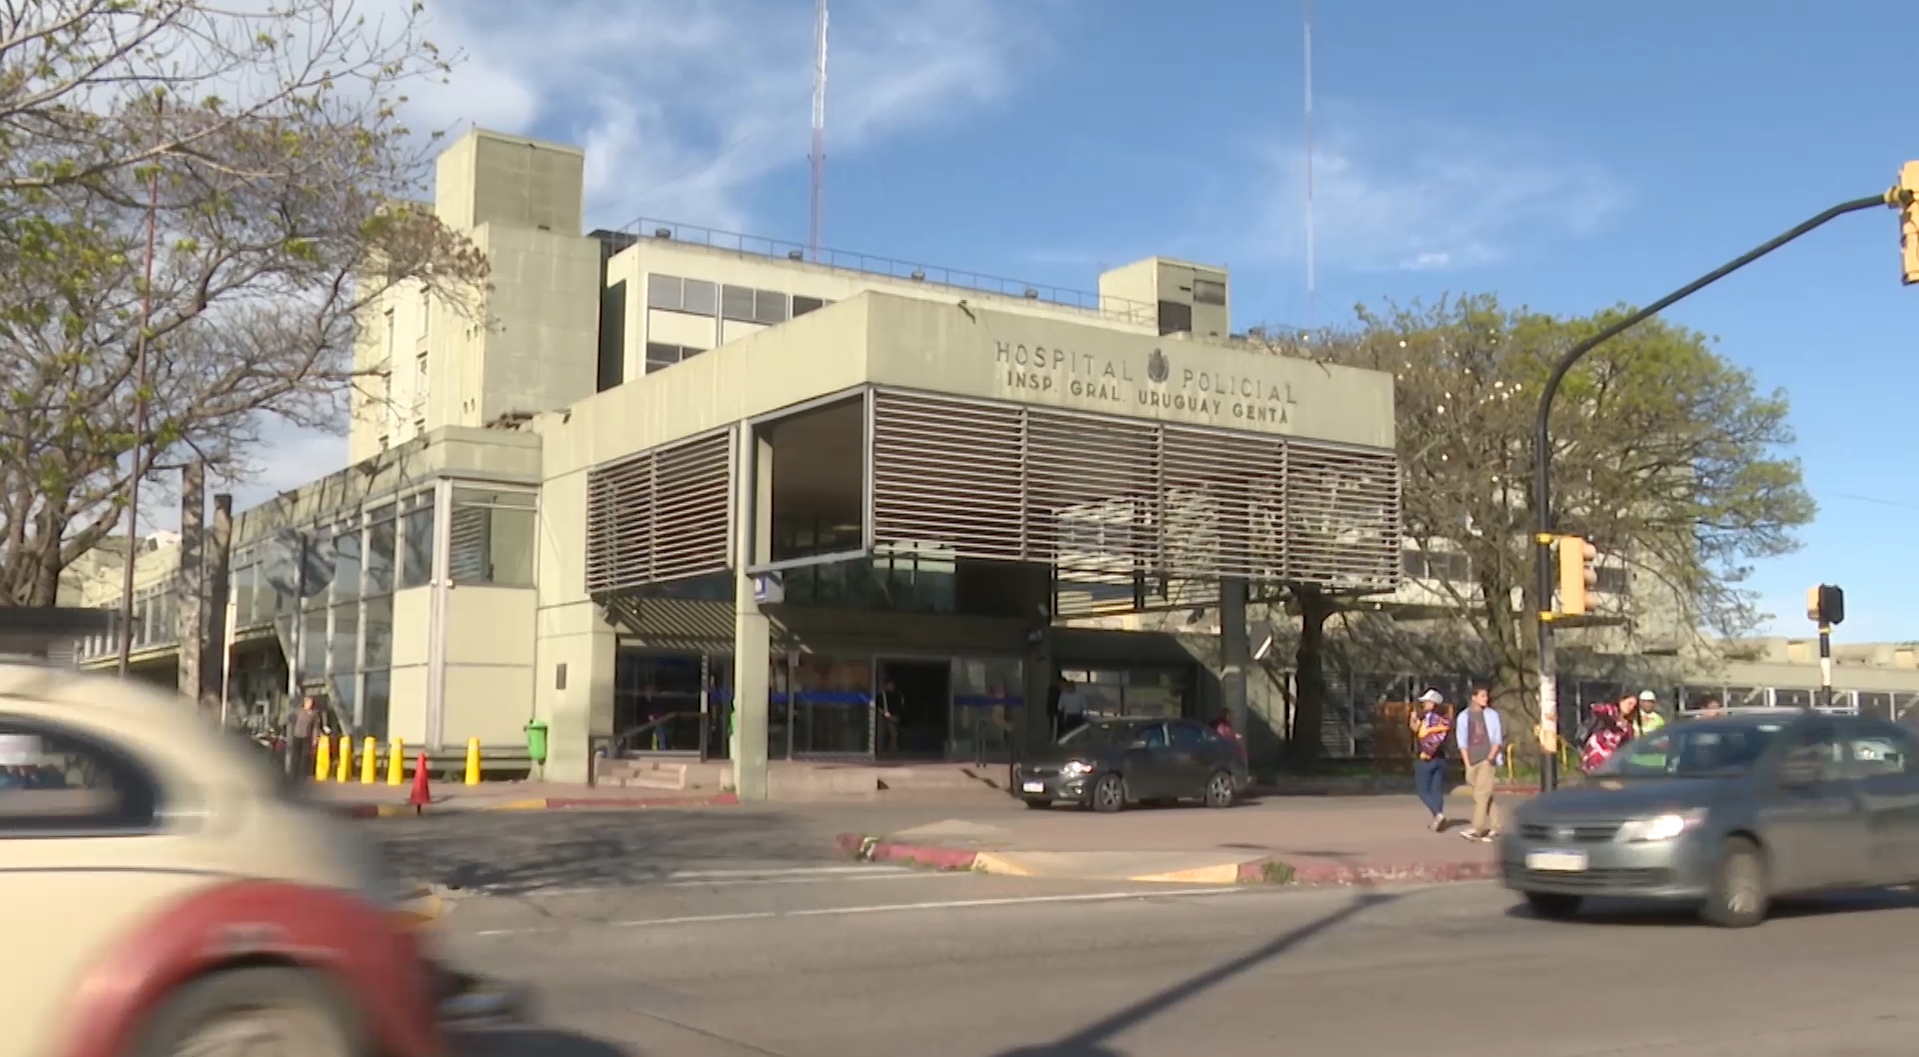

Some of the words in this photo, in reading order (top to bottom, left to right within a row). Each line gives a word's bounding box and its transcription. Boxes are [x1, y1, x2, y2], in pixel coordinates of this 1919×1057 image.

[995, 341, 1133, 382] HOSPITAL
[1182, 368, 1298, 404] POLICIAL
[1006, 371, 1058, 392] INSP.
[1070, 380, 1126, 402] GRAL.
[1138, 389, 1221, 415] URUGUAY
[1232, 403, 1288, 424] GENTA
